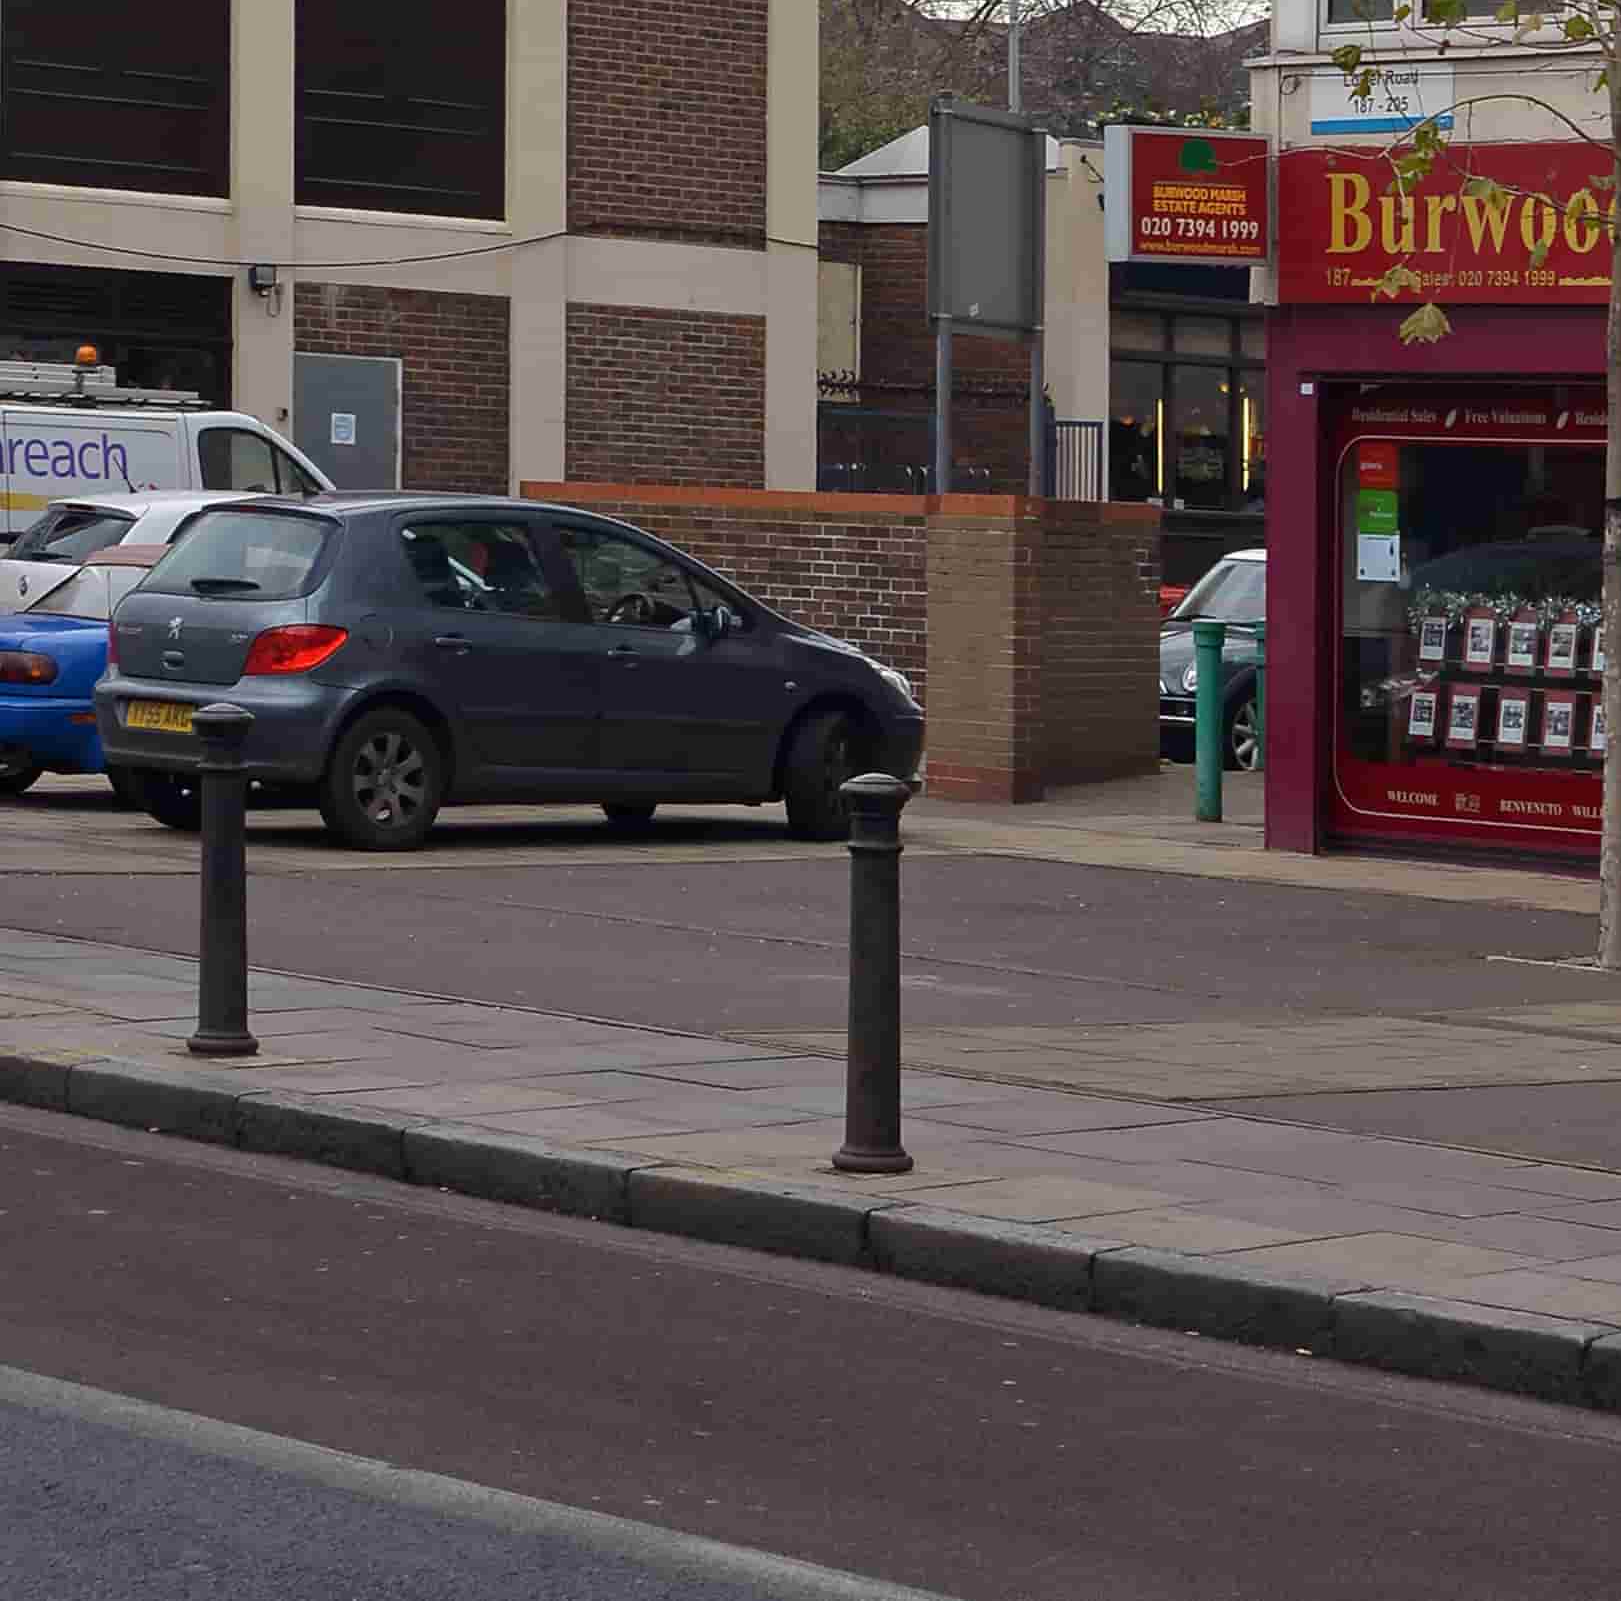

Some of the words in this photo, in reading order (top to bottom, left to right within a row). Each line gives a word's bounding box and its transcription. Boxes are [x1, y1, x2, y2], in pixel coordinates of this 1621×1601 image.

[1343, 72, 1382, 88] Loer
[1384, 69, 1418, 87] Road
[1353, 99, 1374, 114] 187
[1153, 185, 1208, 200] BURWOOD
[1210, 188, 1247, 202] MARSH
[1152, 199, 1197, 213] ESTATE
[1197, 201, 1247, 216] AGENTS
[1140, 217, 1171, 236] 020
[1175, 217, 1216, 238] 7394
[1221, 220, 1259, 240] 1999
[1327, 270, 1351, 287] 187
[1458, 270, 1482, 287] 020
[1487, 270, 1519, 287] 7394
[1524, 270, 1557, 287] 1999
[1464, 409, 1489, 424] Free
[0, 433, 128, 480] reach
[1387, 790, 1440, 807] WELCOME
[1499, 798, 1563, 816] BENVENUTO
